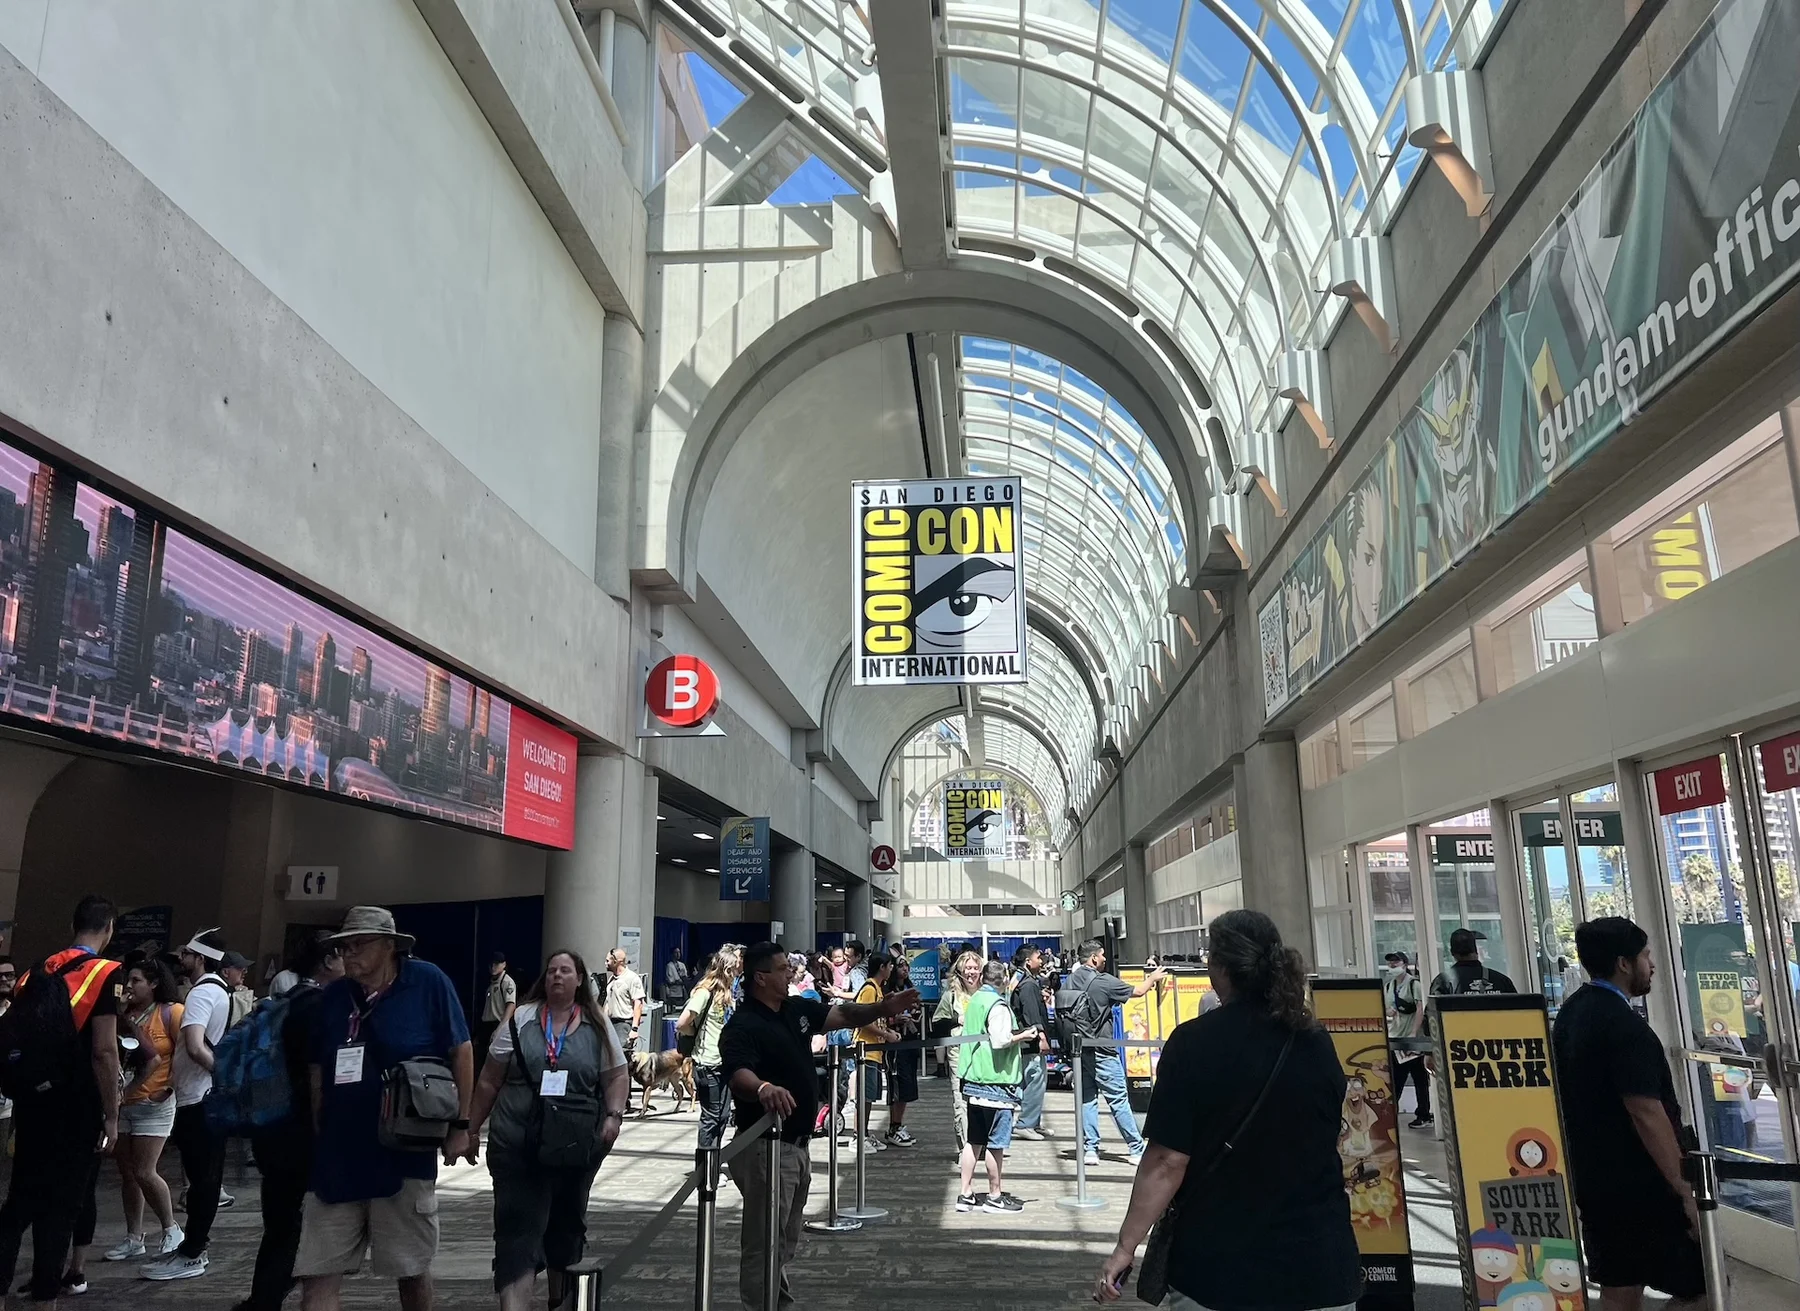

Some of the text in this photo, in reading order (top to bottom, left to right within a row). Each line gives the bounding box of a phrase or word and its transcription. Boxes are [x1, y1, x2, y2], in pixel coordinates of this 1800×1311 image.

[1537, 150, 1800, 473] gundam-offic
[860, 484, 1014, 505] SAN DIEGO
[916, 506, 1014, 555] CON
[863, 508, 913, 654] COMIC
[861, 655, 1021, 678] INTERNATIONAL
[665, 669, 700, 710] B
[522, 738, 567, 775] WELCOME TO
[524, 771, 540, 795] SAN
[971, 781, 1002, 789] DIEGO
[1673, 770, 1702, 801] EXIT
[966, 789, 1003, 809] CON
[946, 789, 966, 847] COMIC
[1542, 818, 1606, 839] ENER
[727, 848, 763, 856] DEAF AND
[876, 849, 891, 866] A
[947, 846, 1005, 856] INTERNATIONAL
[1455, 839, 1494, 857] ENTE
[726, 866, 763, 874] SERVICES
[727, 857, 762, 865] DISABLED
[1449, 1037, 1546, 1062] SOUTH
[1451, 1060, 1551, 1089] PARK
[1487, 1182, 1560, 1209] SOUTH
[1492, 1211, 1564, 1239] PARK
[183, 1258, 202, 1268] HOKA
[1367, 1266, 1396, 1274] COMEDY
[1368, 1274, 1398, 1282] CENTRAL
